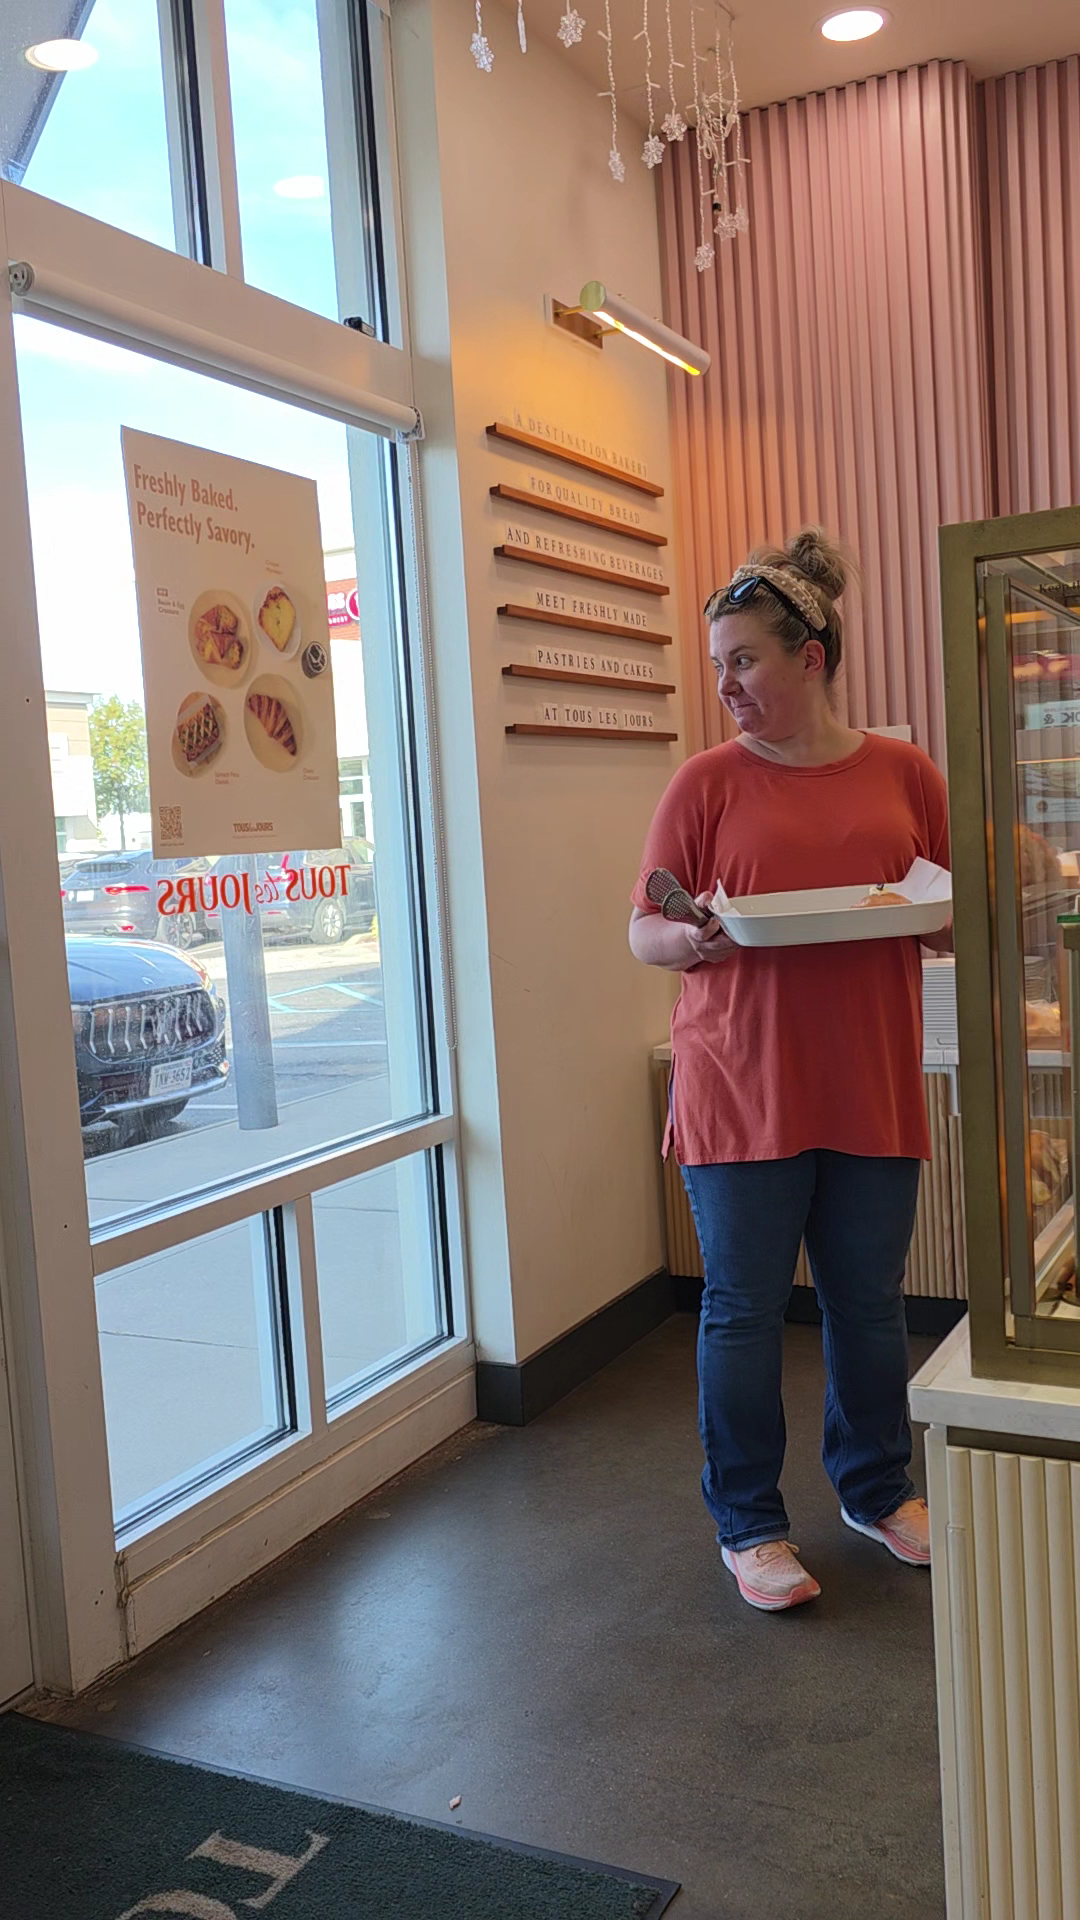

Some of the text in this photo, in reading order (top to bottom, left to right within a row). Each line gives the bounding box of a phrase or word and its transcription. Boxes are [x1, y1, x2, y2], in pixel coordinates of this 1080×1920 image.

[516, 413, 649, 478] A DESTINATION BAKERY
[133, 463, 239, 513] Freshly Baked.
[531, 476, 640, 525] FOR QUALITY BREAD
[136, 500, 256, 555] Perfectly Savory.
[507, 527, 664, 582] AND REFRESHING BEVERAGES
[536, 592, 647, 627] MEET FRESHLY MADE
[537, 650, 654, 679] PASTRIES AND CAKES
[544, 707, 653, 727] AT TOUS LES JOURS
